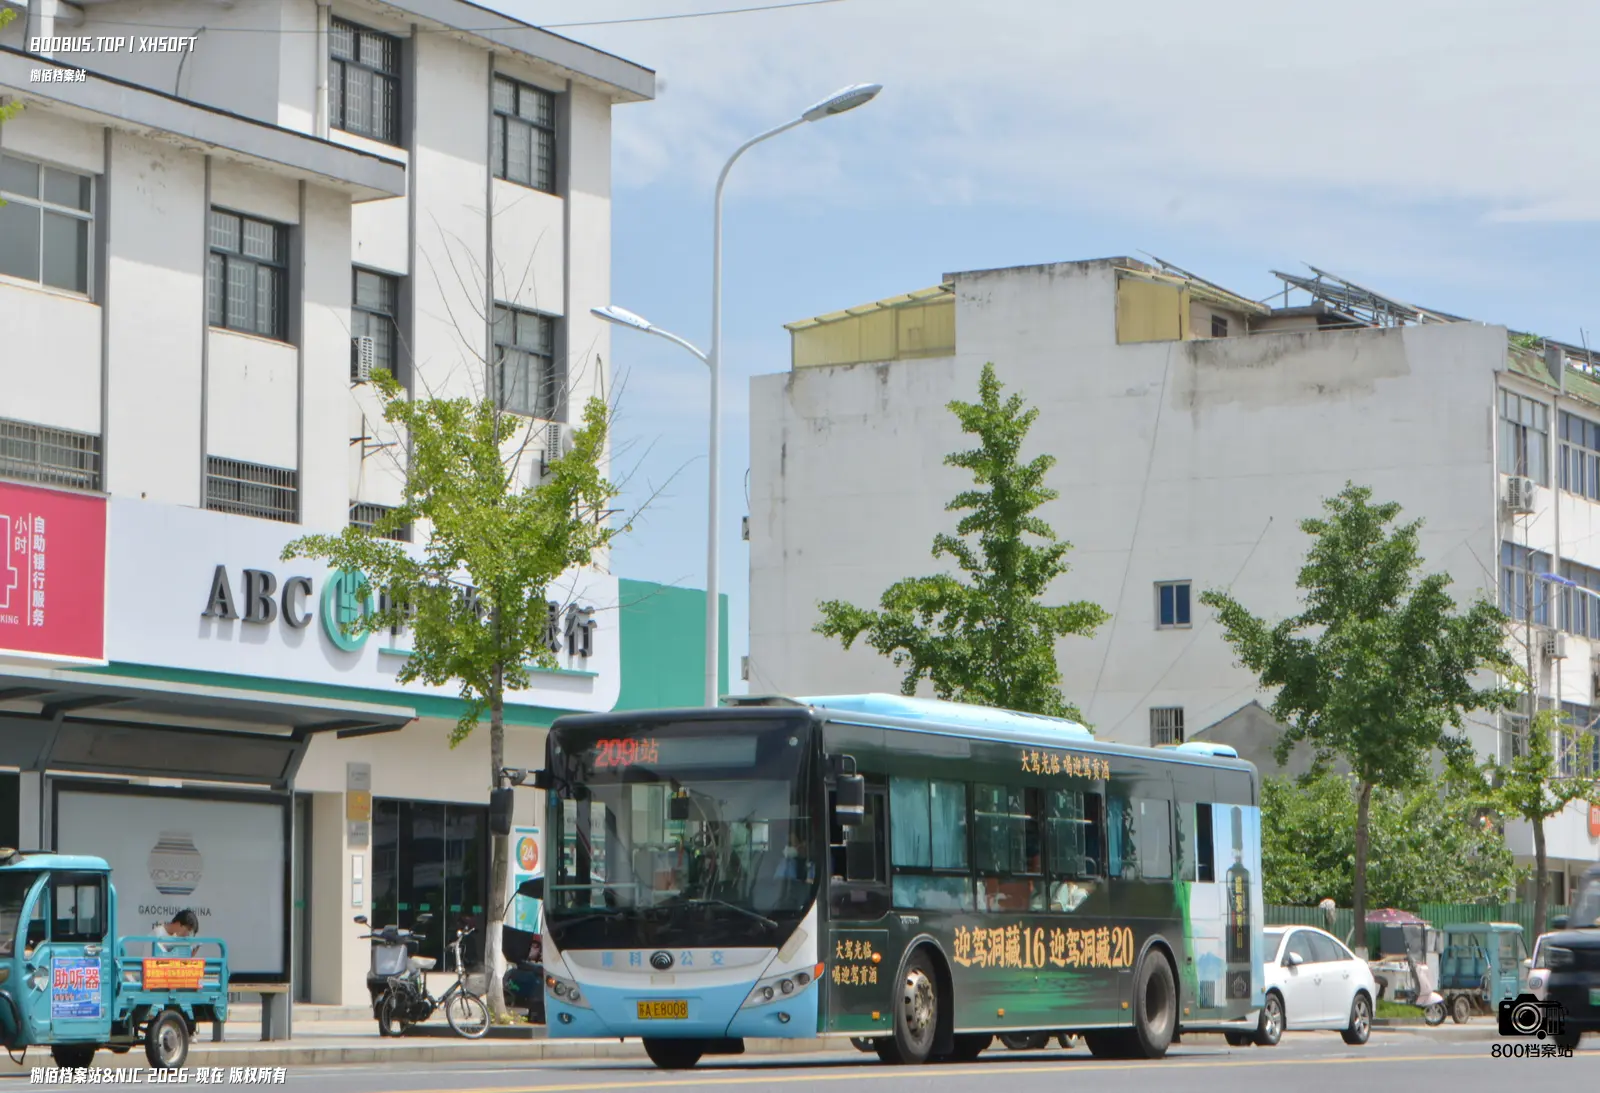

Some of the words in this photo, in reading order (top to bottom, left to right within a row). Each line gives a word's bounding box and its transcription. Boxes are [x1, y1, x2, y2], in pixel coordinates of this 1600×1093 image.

[15, 516, 27, 554] 小时
[33, 516, 45, 626] 自助银行服务
[201, 564, 313, 628] ABC
[594, 738, 635, 767] 209
[1021, 749, 1060, 776] 大驾光临
[1063, 754, 1110, 782] 喝迎驾贡酒
[836, 939, 872, 961] 大驾光临
[953, 925, 1045, 969] 迎驾洞藏16
[1050, 926, 1134, 969] 迎驾洞藏20
[53, 967, 100, 990] 助听器
[832, 964, 877, 986] 喝迎驾贡酒
